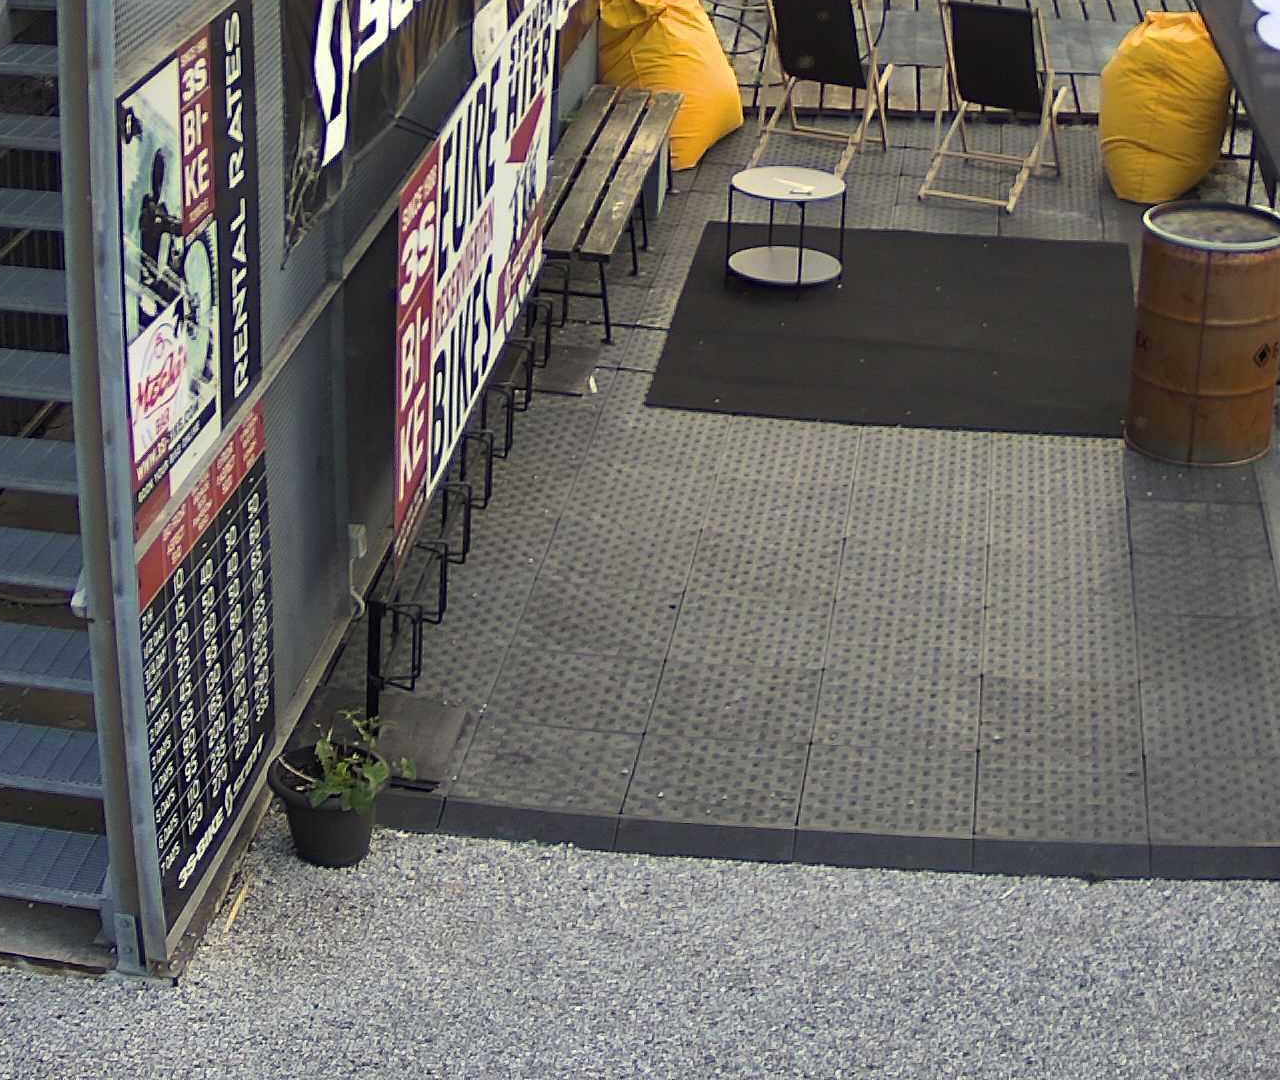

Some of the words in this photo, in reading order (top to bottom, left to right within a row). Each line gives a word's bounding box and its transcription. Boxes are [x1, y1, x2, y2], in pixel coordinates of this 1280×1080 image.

[182, 56, 209, 102] 3S
[224, 10, 246, 190] RATES
[507, 24, 551, 136] HIER
[182, 107, 209, 157] BI-
[184, 152, 210, 208] KE
[440, 55, 502, 283] EURE
[401, 201, 437, 305] 3S
[232, 199, 251, 400] RENTAL
[400, 306, 431, 413] BI-
[431, 254, 493, 481] BIKES
[399, 382, 426, 503] KE
[173, 567, 185, 595] 10
[175, 595, 186, 622] 15
[175, 622, 189, 652] 20
[177, 648, 190, 679] 25
[153, 707, 170, 735] DAYS
[179, 674, 192, 702] 45
[156, 734, 172, 764] DAYS
[181, 700, 194, 730] 65
[158, 760, 174, 789] DAYS
[182, 727, 196, 757] 80
[160, 786, 176, 816] DAYS
[184, 752, 198, 782] 95
[164, 813, 180, 841] DAYS
[187, 779, 200, 808] 110
[166, 840, 181, 870] DAYS
[188, 802, 203, 836] 120
